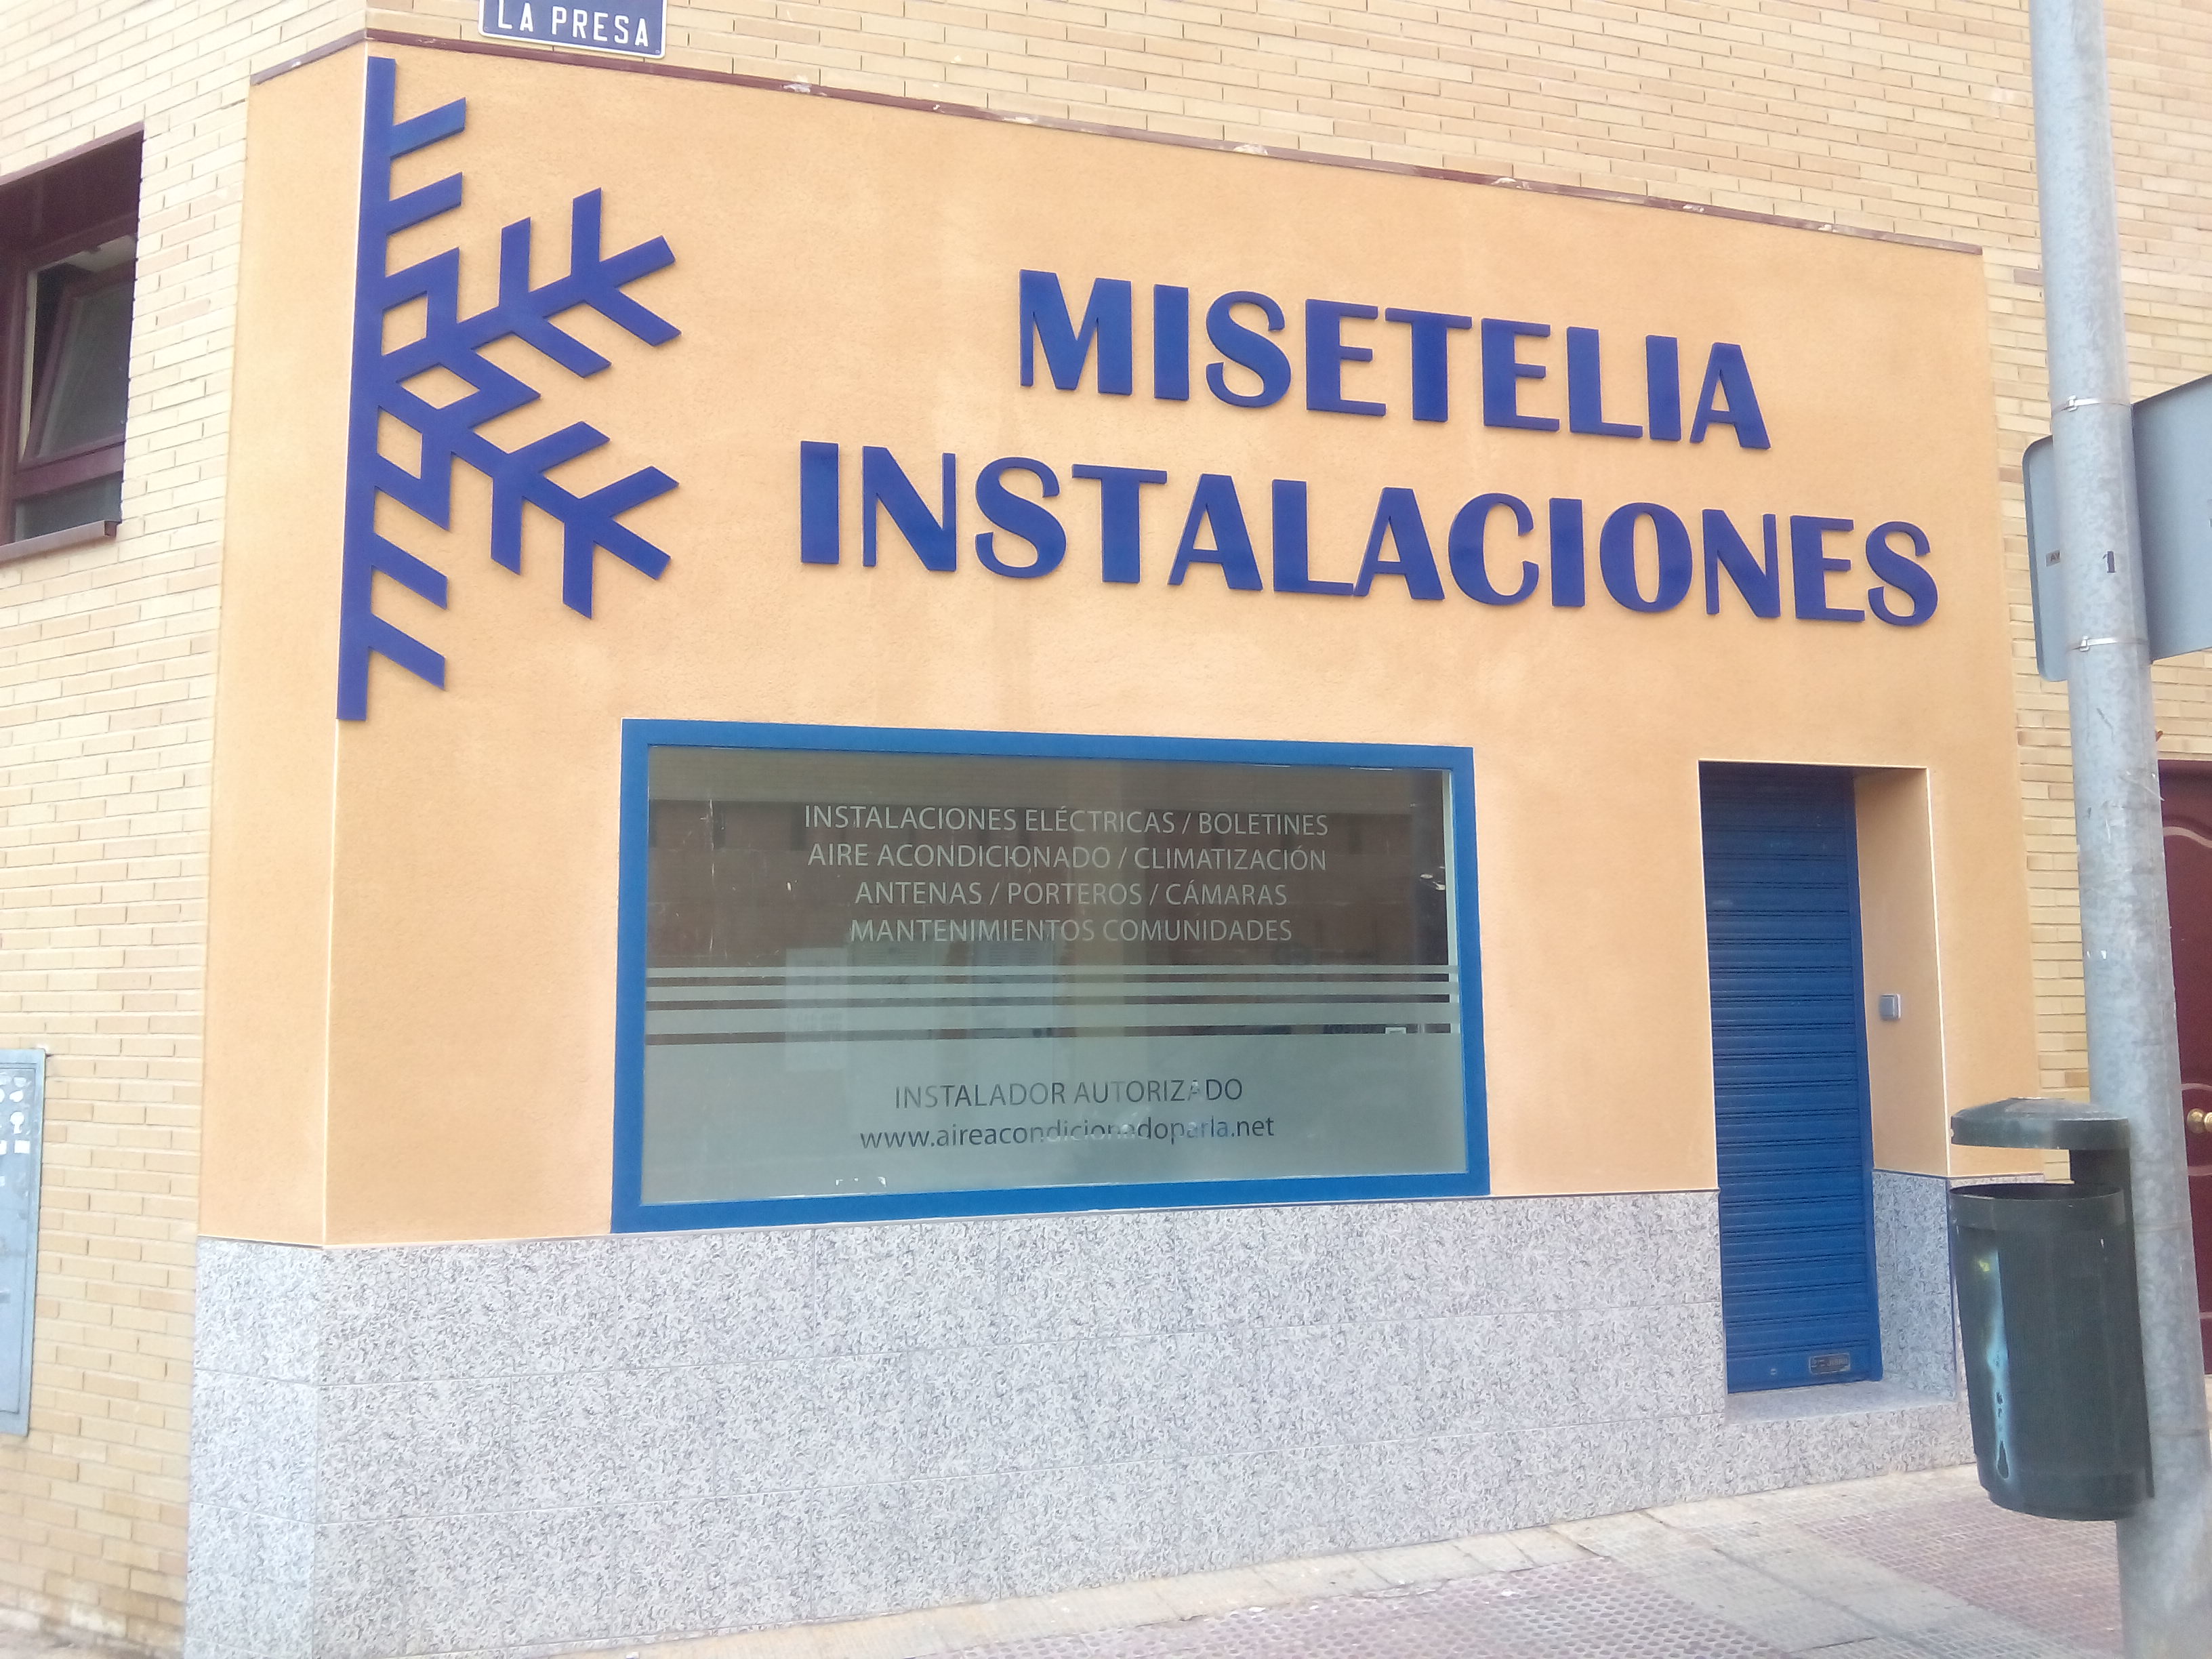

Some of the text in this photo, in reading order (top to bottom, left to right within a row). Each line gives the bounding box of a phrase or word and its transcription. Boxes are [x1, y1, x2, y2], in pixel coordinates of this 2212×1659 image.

[497, 0, 649, 47] LA PRESA
[1019, 269, 1771, 449] MISETELIA
[800, 441, 1938, 626] INSTALACIONES
[804, 805, 1017, 831] INSTALACIONES
[1025, 806, 1175, 834] ELÉCTRICAS
[1198, 812, 1328, 836] BOLETINES
[807, 843, 869, 867] AIRE
[877, 844, 1111, 869] ACONDICIONADO
[1134, 844, 1326, 871] CLIMATIZACIÓN
[855, 881, 982, 905] ANTENAS
[1008, 882, 1142, 905] PORTEROS
[1166, 879, 1287, 906] CÁMARAS
[851, 919, 1292, 942] MANTENIMIENTOS COMUNIDADES
[895, 1078, 1243, 1109] INSTALADOR AUTORIZADO
[860, 1117, 1275, 1149] www.aireacondicionadoparla.net
